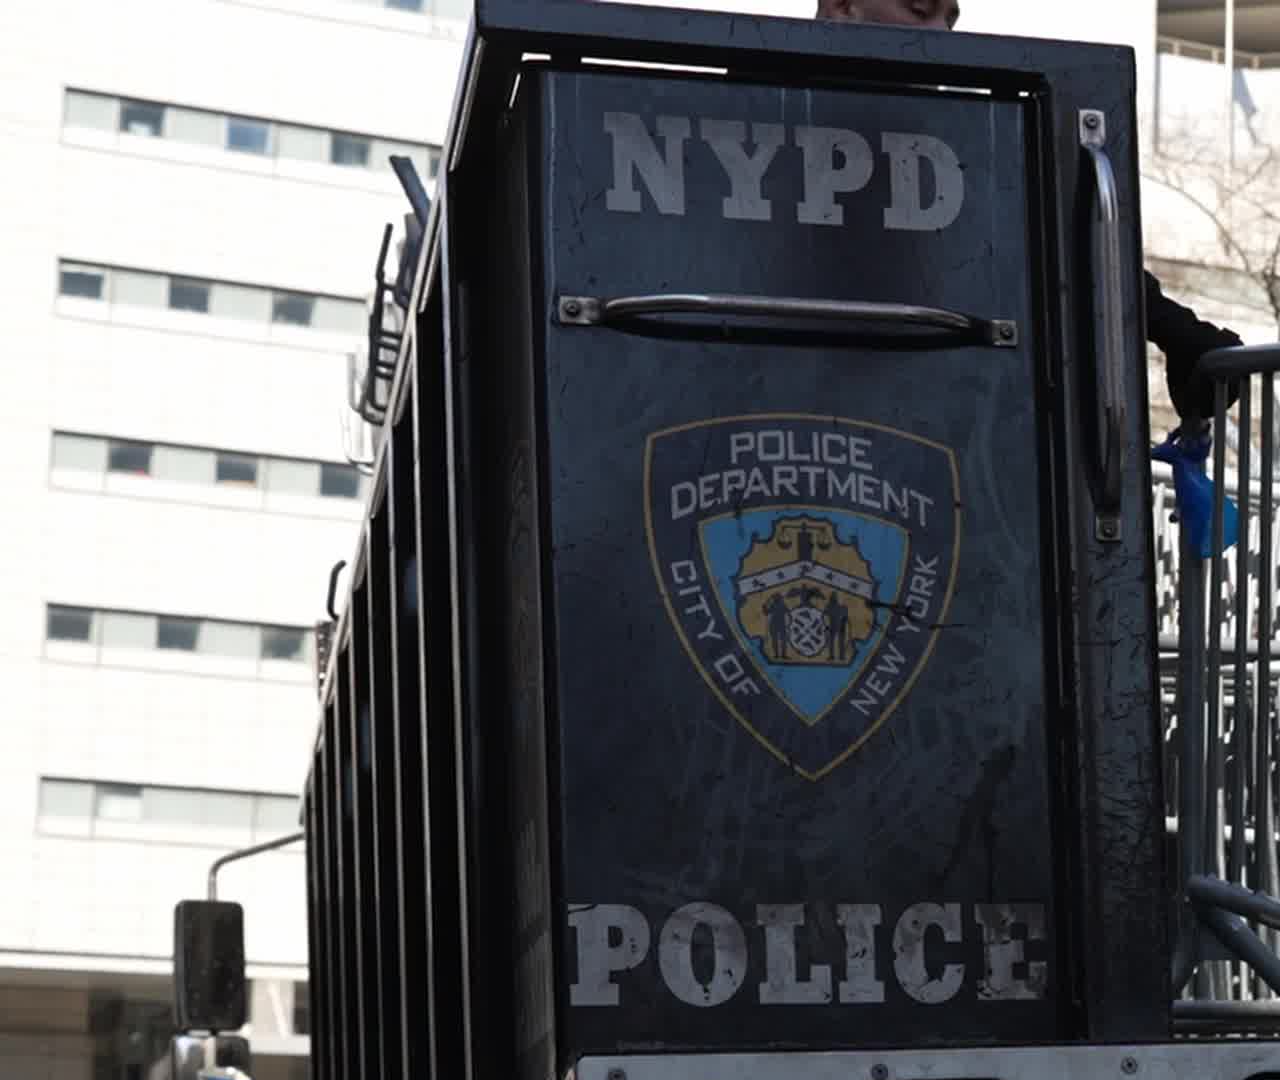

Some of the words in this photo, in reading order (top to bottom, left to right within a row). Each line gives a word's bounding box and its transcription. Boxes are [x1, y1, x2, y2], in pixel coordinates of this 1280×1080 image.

[604, 111, 965, 231] NYPD
[671, 466, 934, 527] DEPARTMENT
[730, 430, 872, 470] POLICE
[671, 559, 724, 642] CITY
[713, 653, 760, 697] OF
[850, 643, 906, 716] NEW
[896, 553, 939, 634] YORK
[567, 901, 1048, 1006] POLICE
